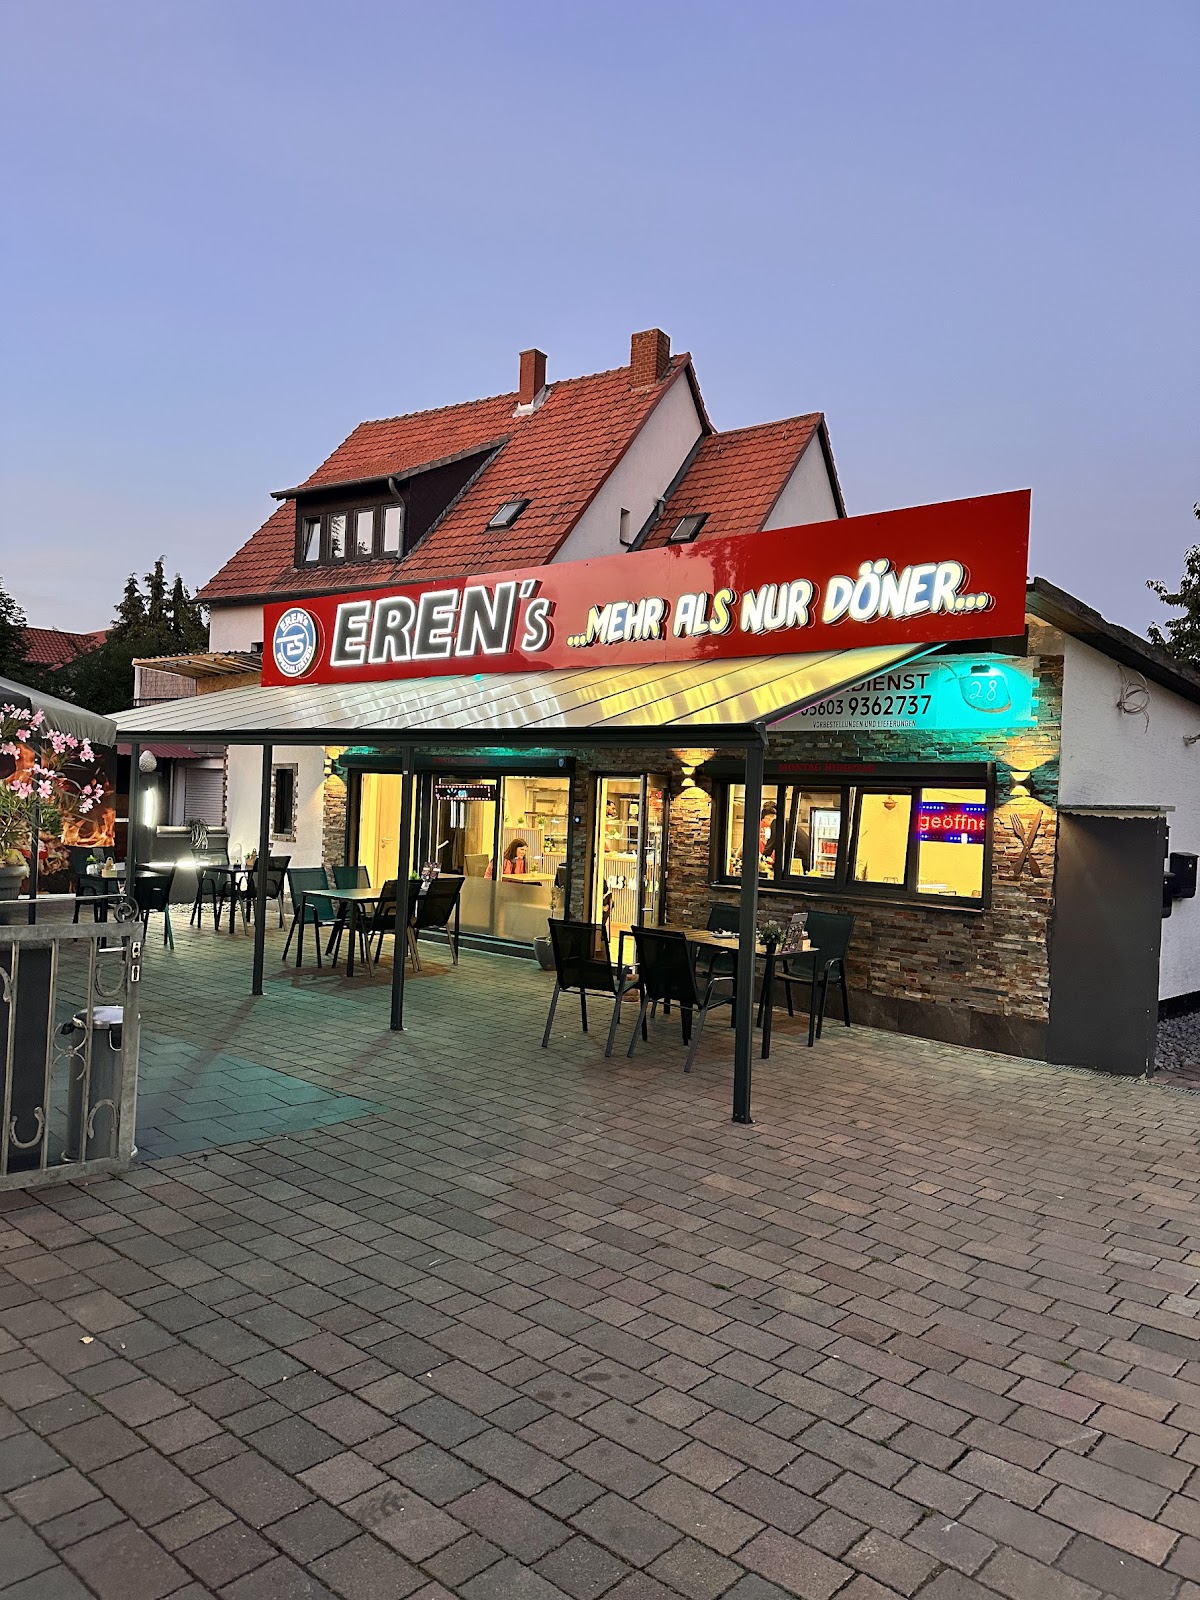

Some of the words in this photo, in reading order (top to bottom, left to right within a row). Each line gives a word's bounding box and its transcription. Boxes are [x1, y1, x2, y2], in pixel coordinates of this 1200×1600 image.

[672, 588, 737, 638] ALS
[740, 578, 817, 635] NUR
[845, 673, 931, 693] DIENST
[969, 680, 997, 701] 28
[848, 694, 933, 717] 9362737
[864, 720, 876, 728] UND
[877, 719, 917, 728] LIEFERUNGEN
